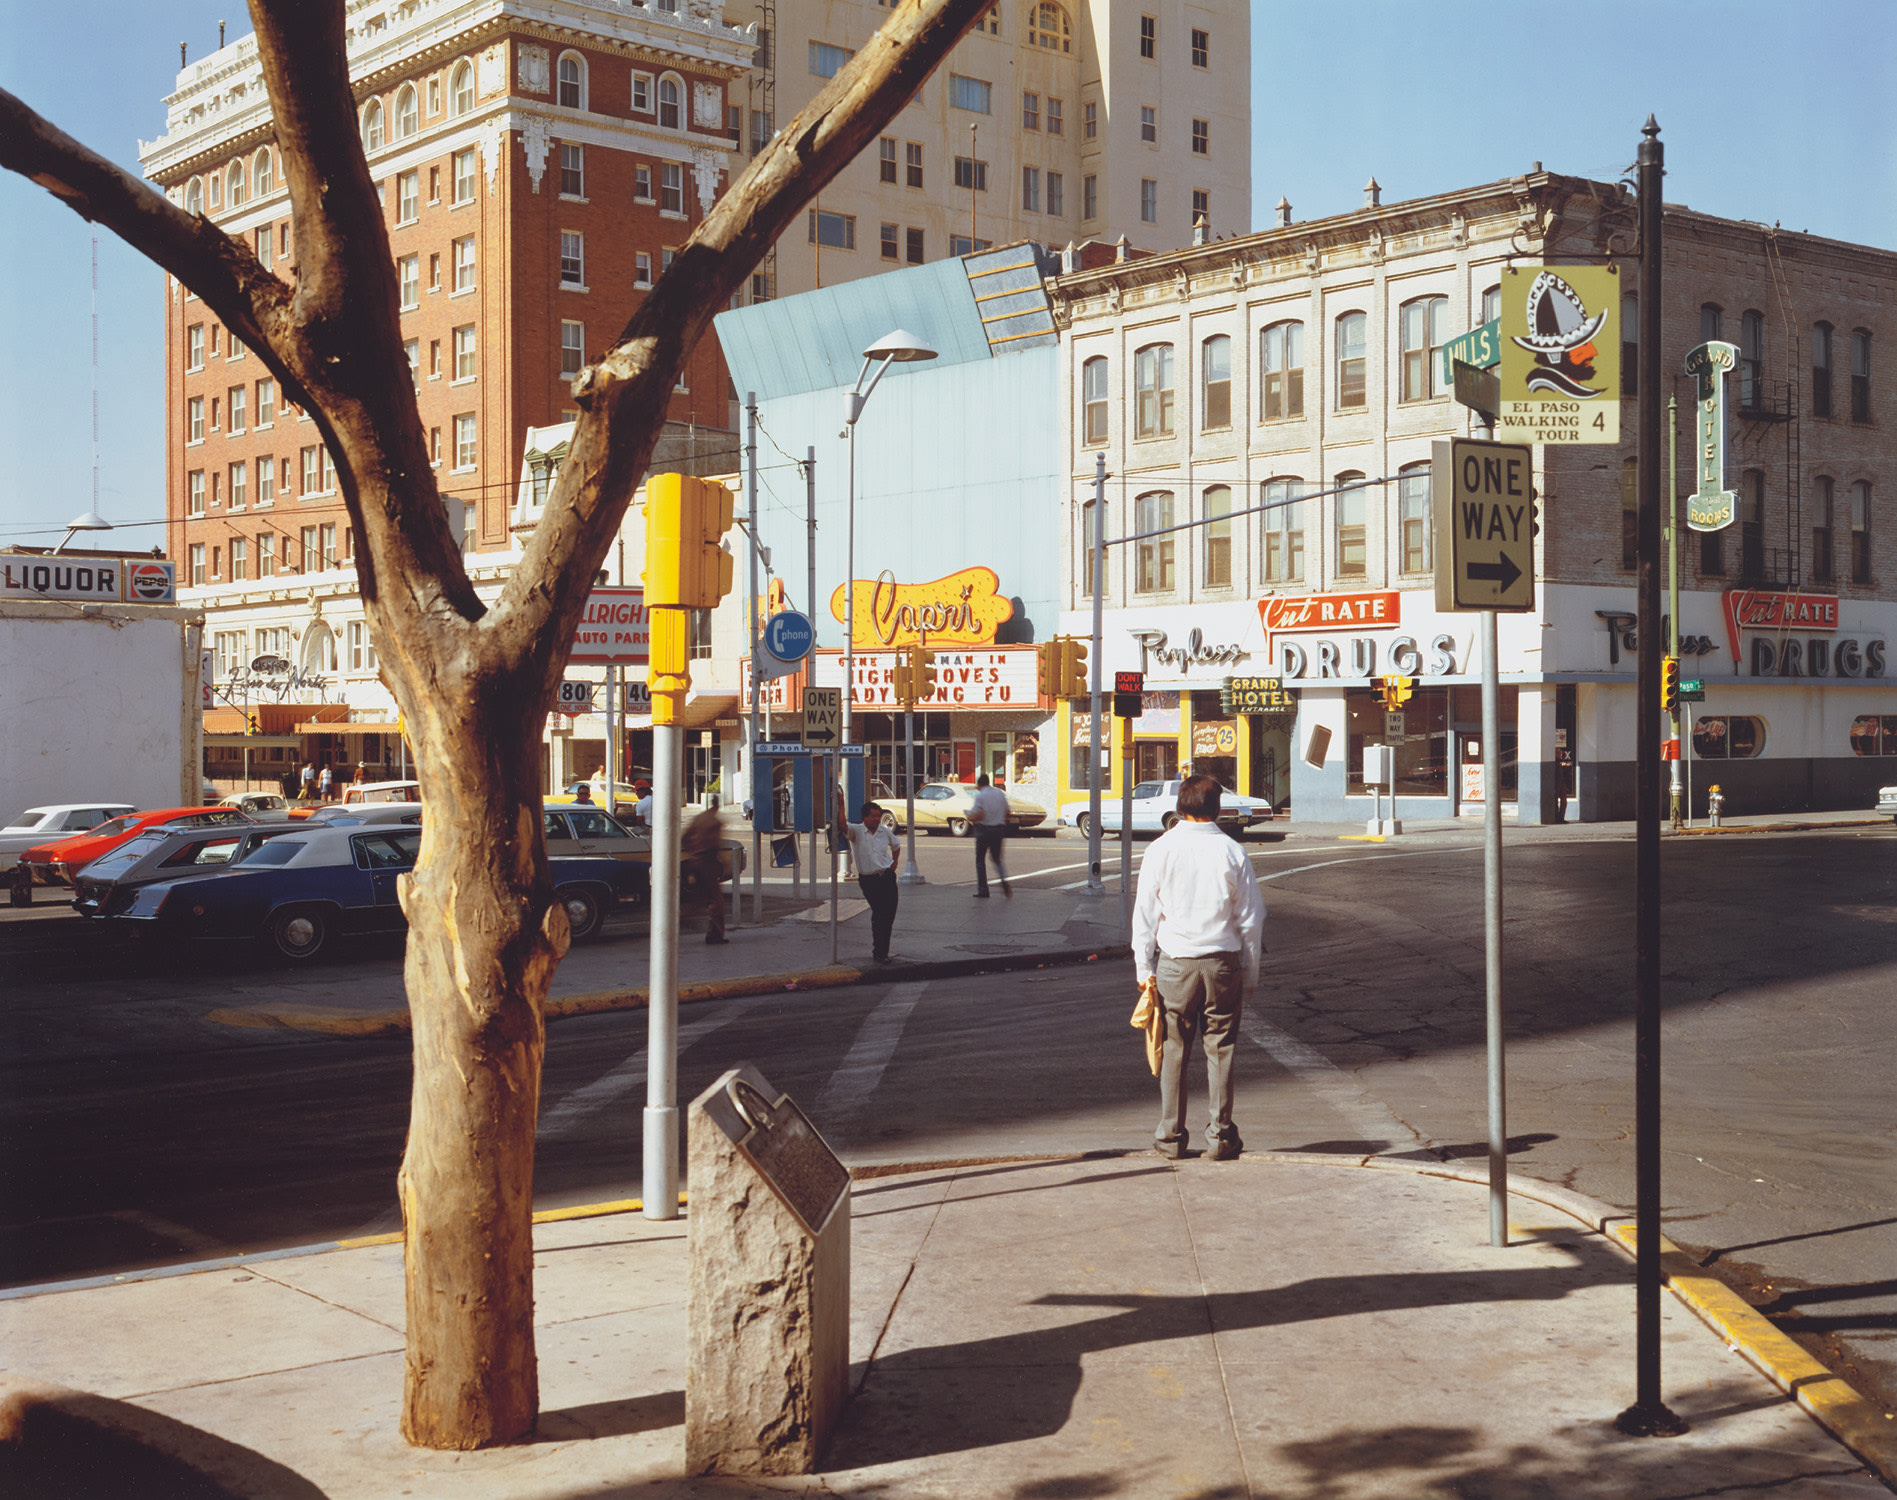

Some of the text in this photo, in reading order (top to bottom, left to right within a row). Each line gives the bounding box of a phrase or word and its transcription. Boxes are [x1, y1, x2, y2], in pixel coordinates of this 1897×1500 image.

[1449, 330, 1490, 376] MILLS
[1687, 349, 1733, 372] GRAND
[1512, 402, 1580, 413] EL PASO
[1503, 416, 1580, 426] WALKING
[1592, 411, 1605, 432] 4
[1704, 374, 1716, 483] HOTEL
[1536, 430, 1580, 441] TOUR
[1463, 455, 1522, 496] ONE
[1462, 502, 1525, 542] WAY
[1691, 507, 1730, 526] ROOMS
[5, 565, 114, 592] LIQUOR
[134, 576, 168, 588] PEPSI
[871, 569, 982, 646] Capri
[1263, 594, 1385, 629] Cut RATE
[1736, 588, 1834, 627] Cut RATE
[575, 632, 649, 643] AUTO PARK
[781, 630, 809, 641] phone
[989, 654, 1006, 665] IN
[1126, 627, 1251, 675] Payless
[1280, 634, 1457, 679] DRUGS
[1751, 638, 1886, 678] DRUGS
[851, 667, 999, 684] IGH OVES
[1117, 673, 1140, 682] DONT
[1117, 683, 1140, 692] WALK
[1231, 679, 1279, 690] GRAND
[808, 691, 837, 706] ONE
[851, 687, 889, 702] ADY
[985, 685, 1011, 702] FU
[1231, 691, 1294, 706] HOTEL
[807, 710, 838, 724] WAY
[1219, 728, 1234, 745] 25
